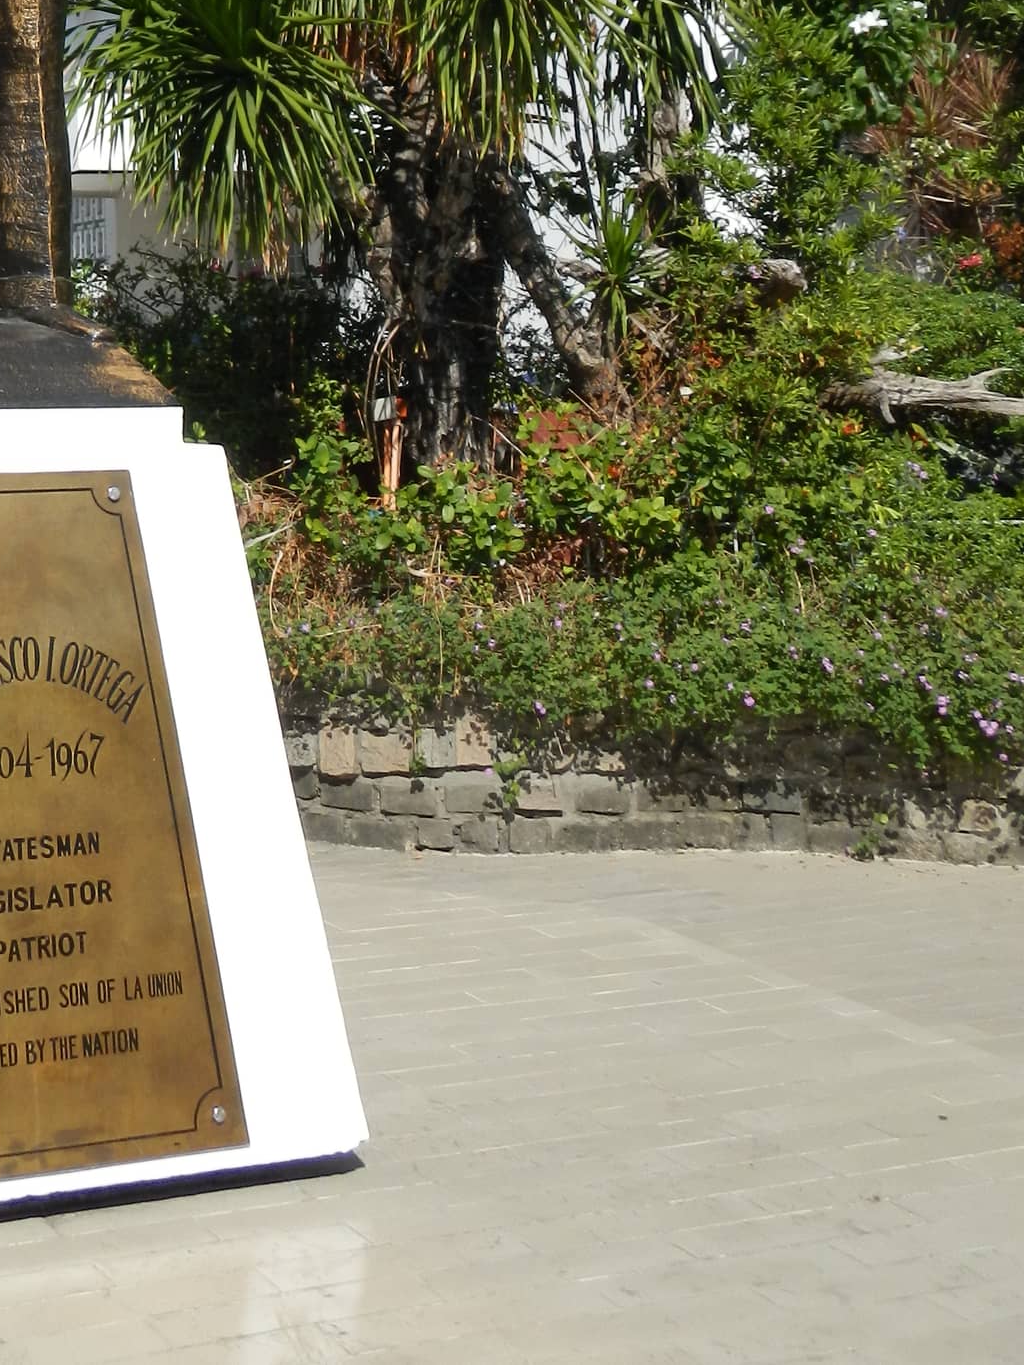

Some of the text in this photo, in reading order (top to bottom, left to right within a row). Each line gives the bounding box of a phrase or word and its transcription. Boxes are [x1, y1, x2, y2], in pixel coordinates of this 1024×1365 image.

[61, 641, 146, 724] ORTEGA
[59, 981, 88, 1008] SON
[97, 979, 115, 1002] OF
[124, 975, 143, 1000] LA
[148, 971, 183, 998] UNION
[26, 1040, 46, 1065] BY
[50, 1036, 78, 1061] THE
[82, 1029, 139, 1057] NATION
